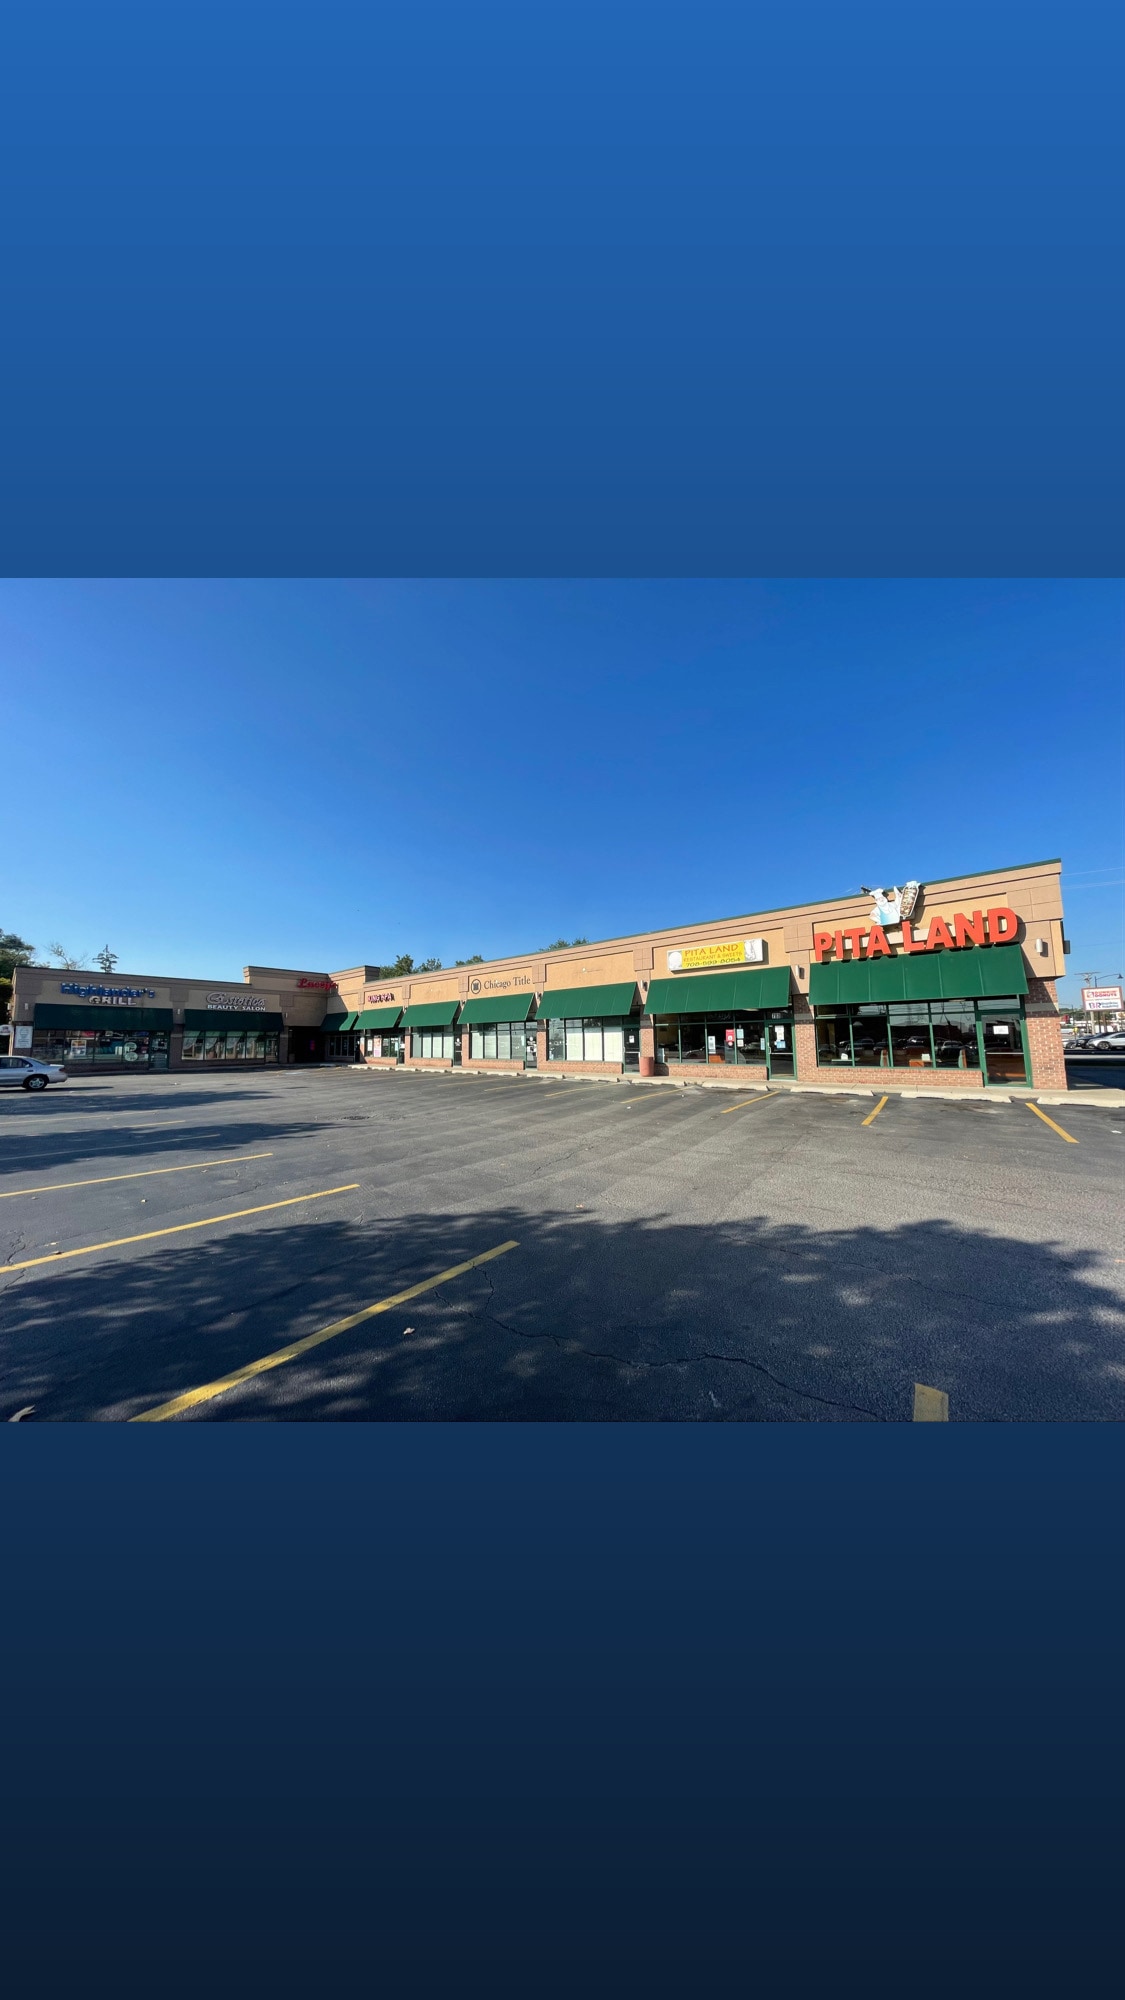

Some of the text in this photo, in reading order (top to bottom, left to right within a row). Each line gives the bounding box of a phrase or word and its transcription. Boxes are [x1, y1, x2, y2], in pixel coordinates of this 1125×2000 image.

[814, 907, 1018, 962] PITA LAND
[684, 943, 739, 957] PITA LAND
[683, 954, 716, 962] RESTAURANT
[483, 975, 531, 989] Chicago Title
[88, 995, 137, 1006] GRILL
